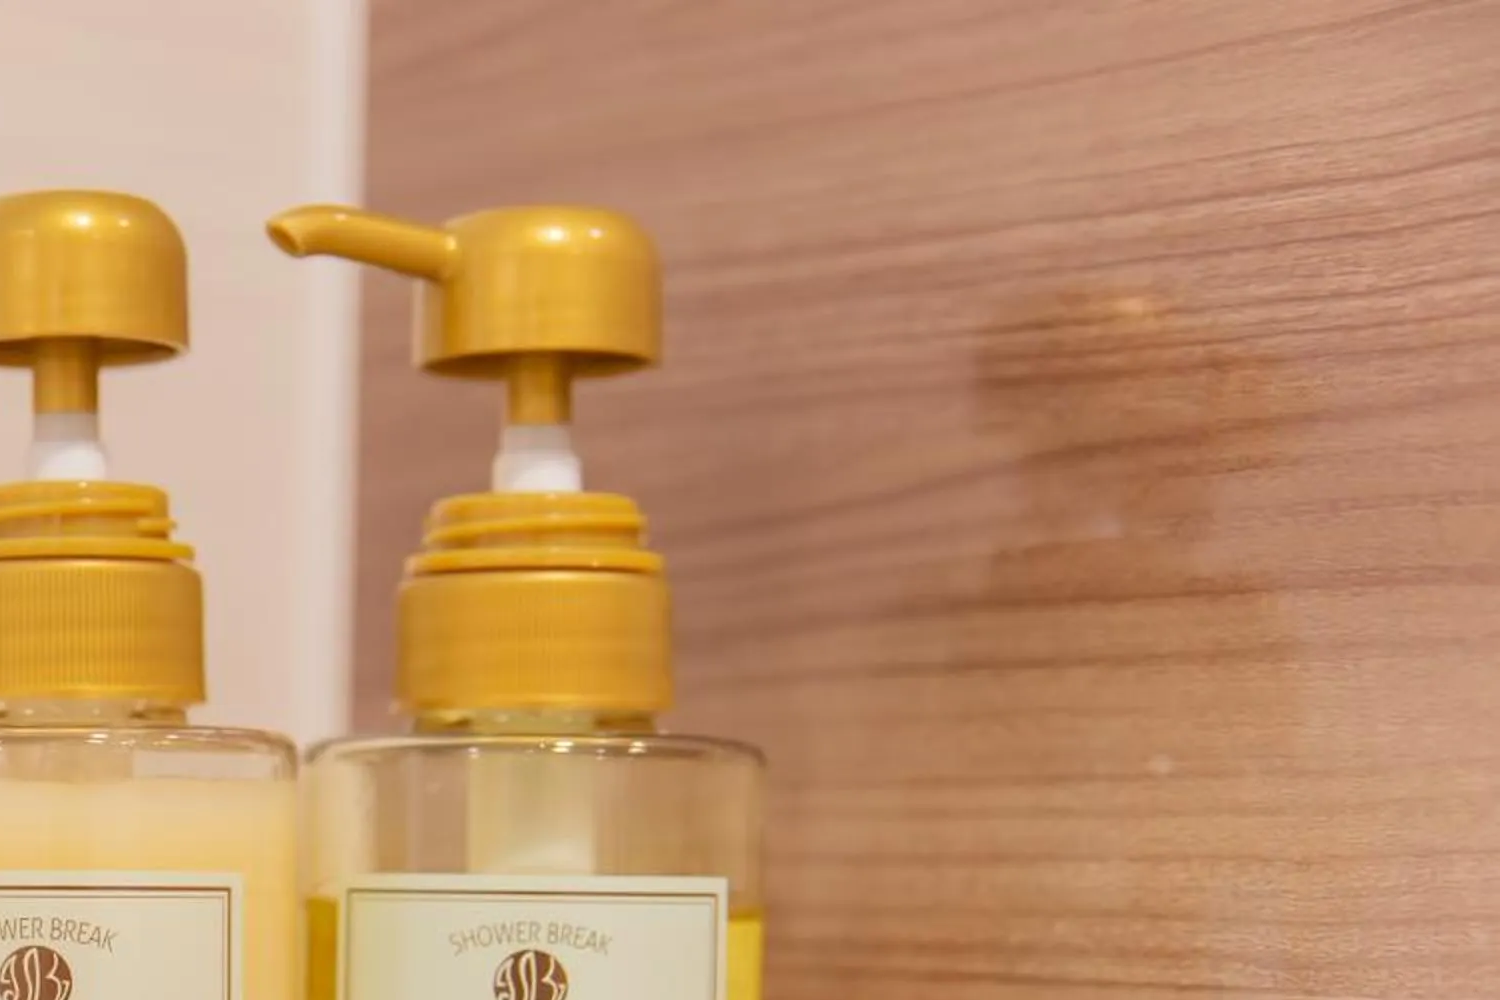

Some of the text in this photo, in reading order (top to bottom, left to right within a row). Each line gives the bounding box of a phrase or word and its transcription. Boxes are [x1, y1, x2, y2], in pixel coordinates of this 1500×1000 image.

[50, 917, 119, 953] BREAK
[448, 920, 612, 956] SHOWER BREAK
